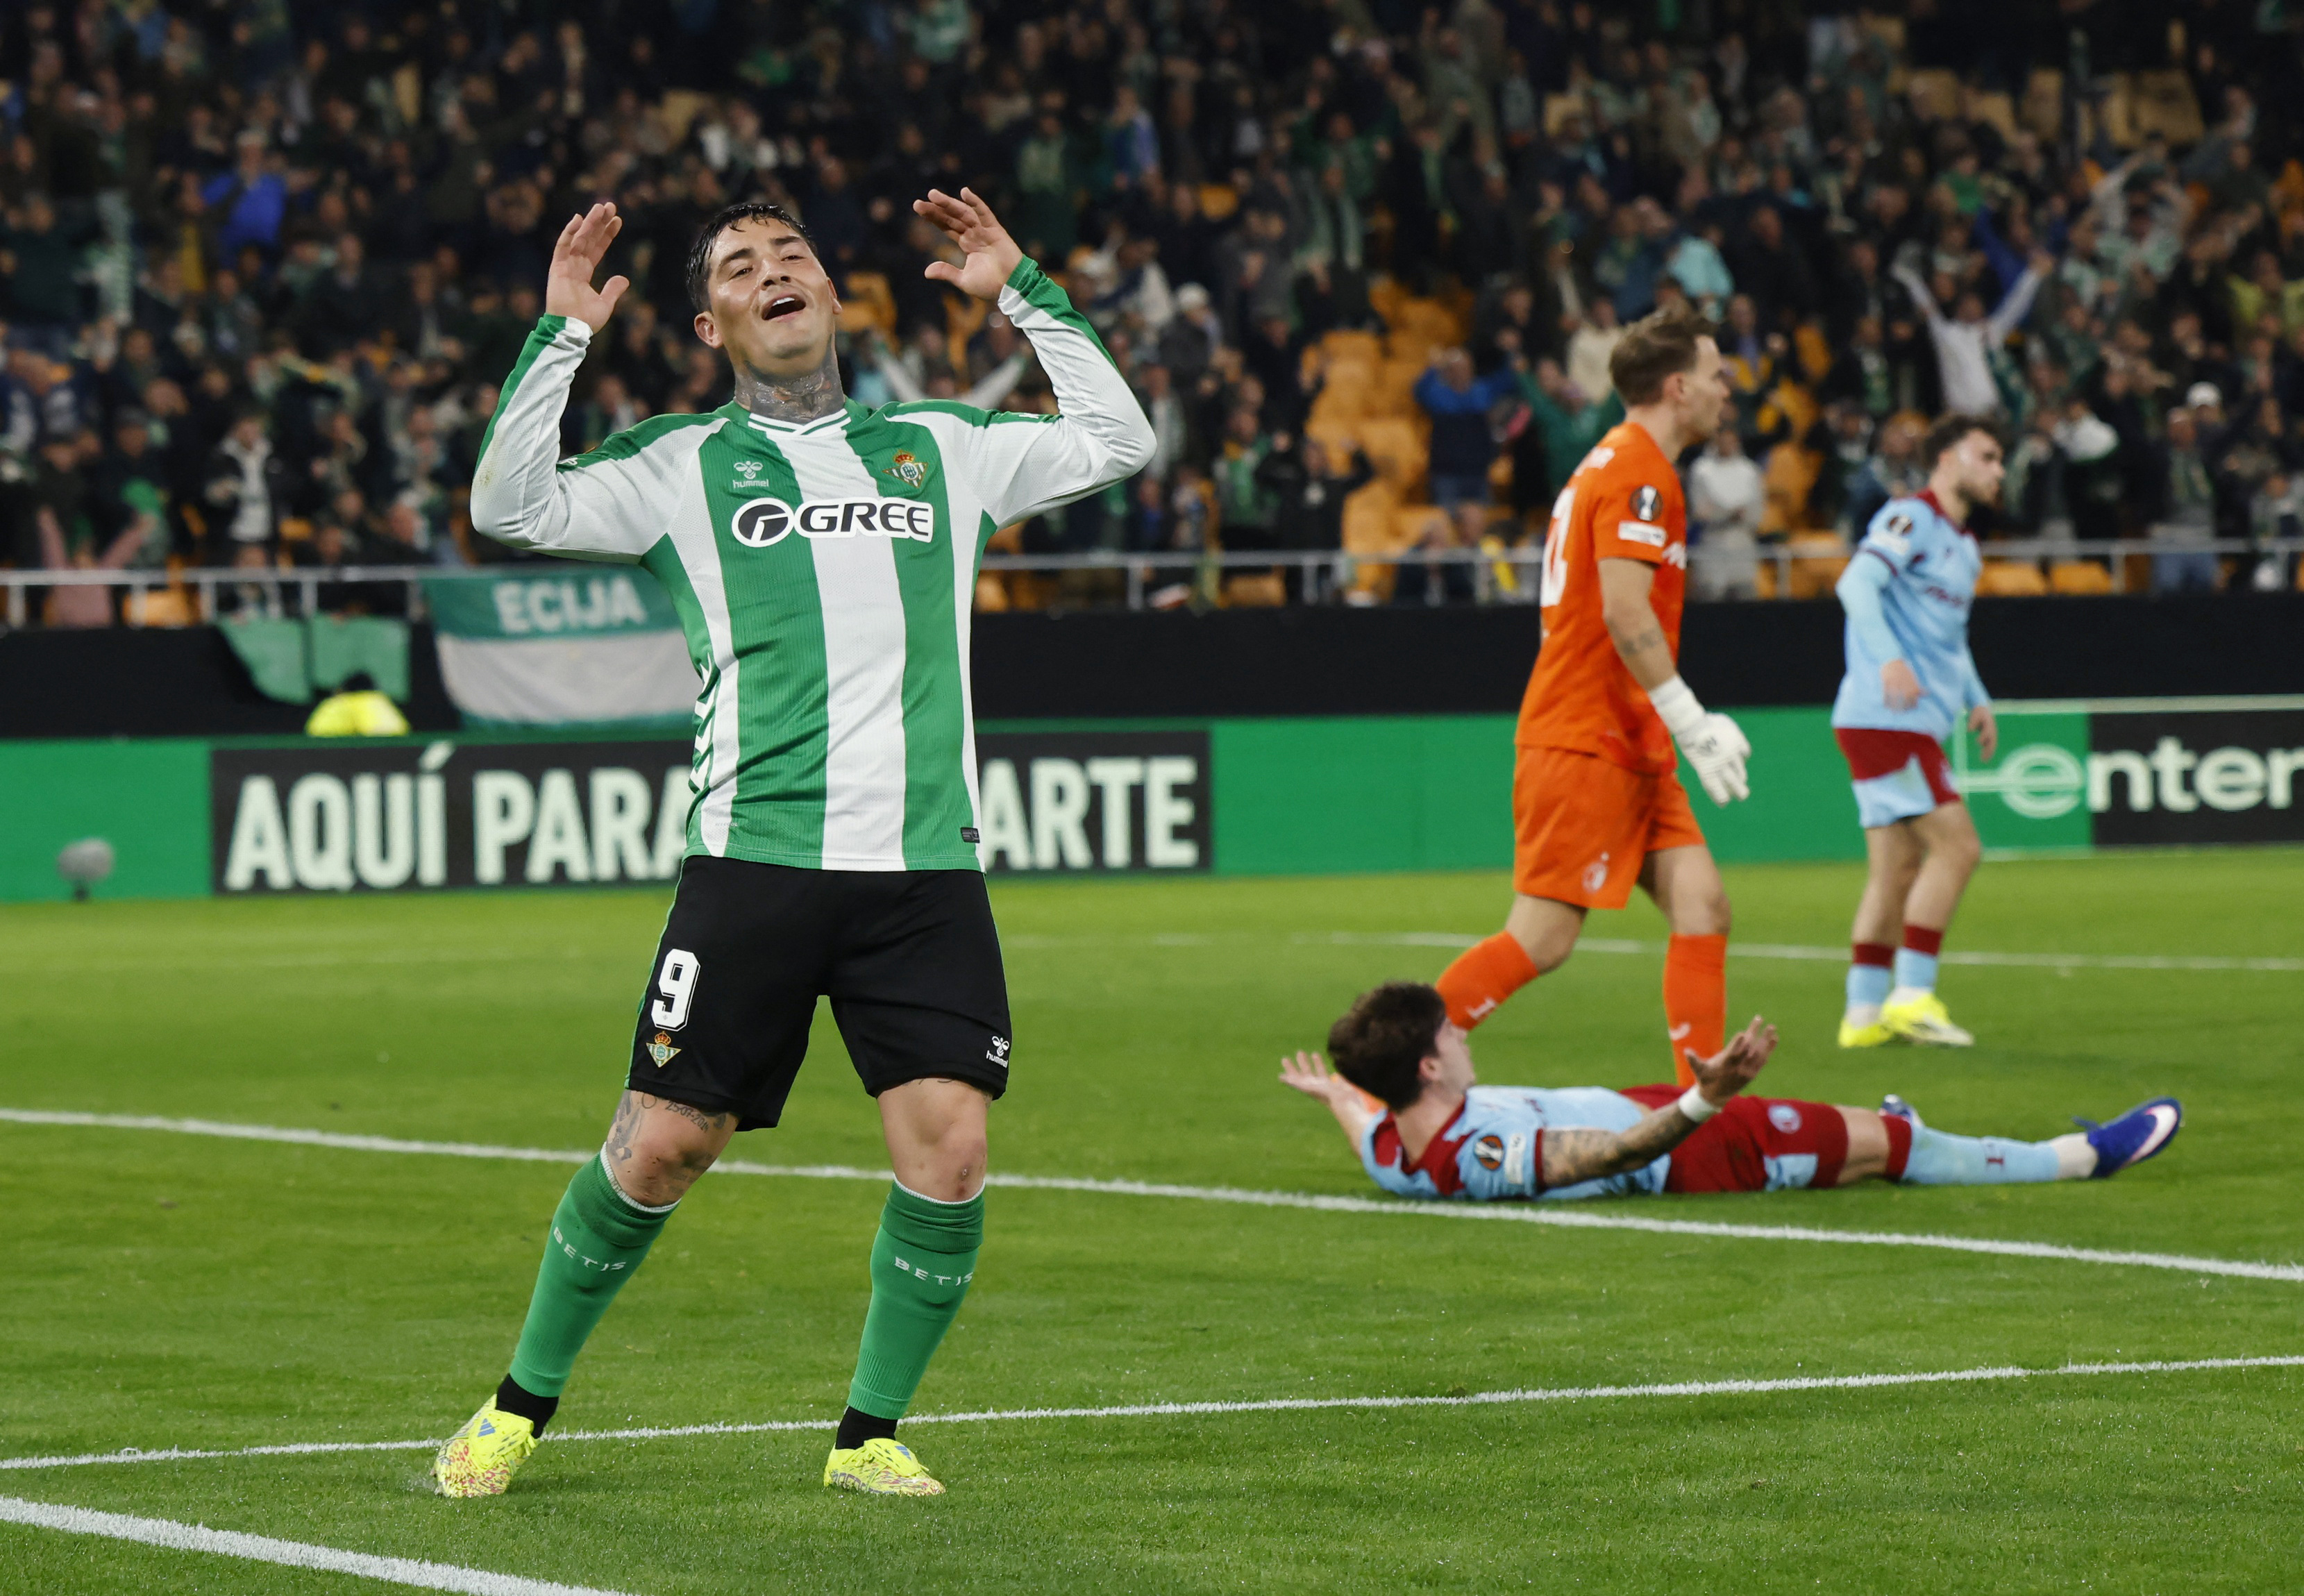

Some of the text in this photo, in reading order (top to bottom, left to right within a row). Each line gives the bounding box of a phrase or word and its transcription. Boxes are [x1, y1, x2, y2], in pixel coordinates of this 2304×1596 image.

[732, 478, 769, 489] hummel
[799, 501, 930, 536] GREE
[224, 741, 456, 891] AQUÍ
[650, 948, 701, 1032] 9
[553, 1227, 626, 1271] BETIS
[895, 1257, 973, 1286] BETIS
